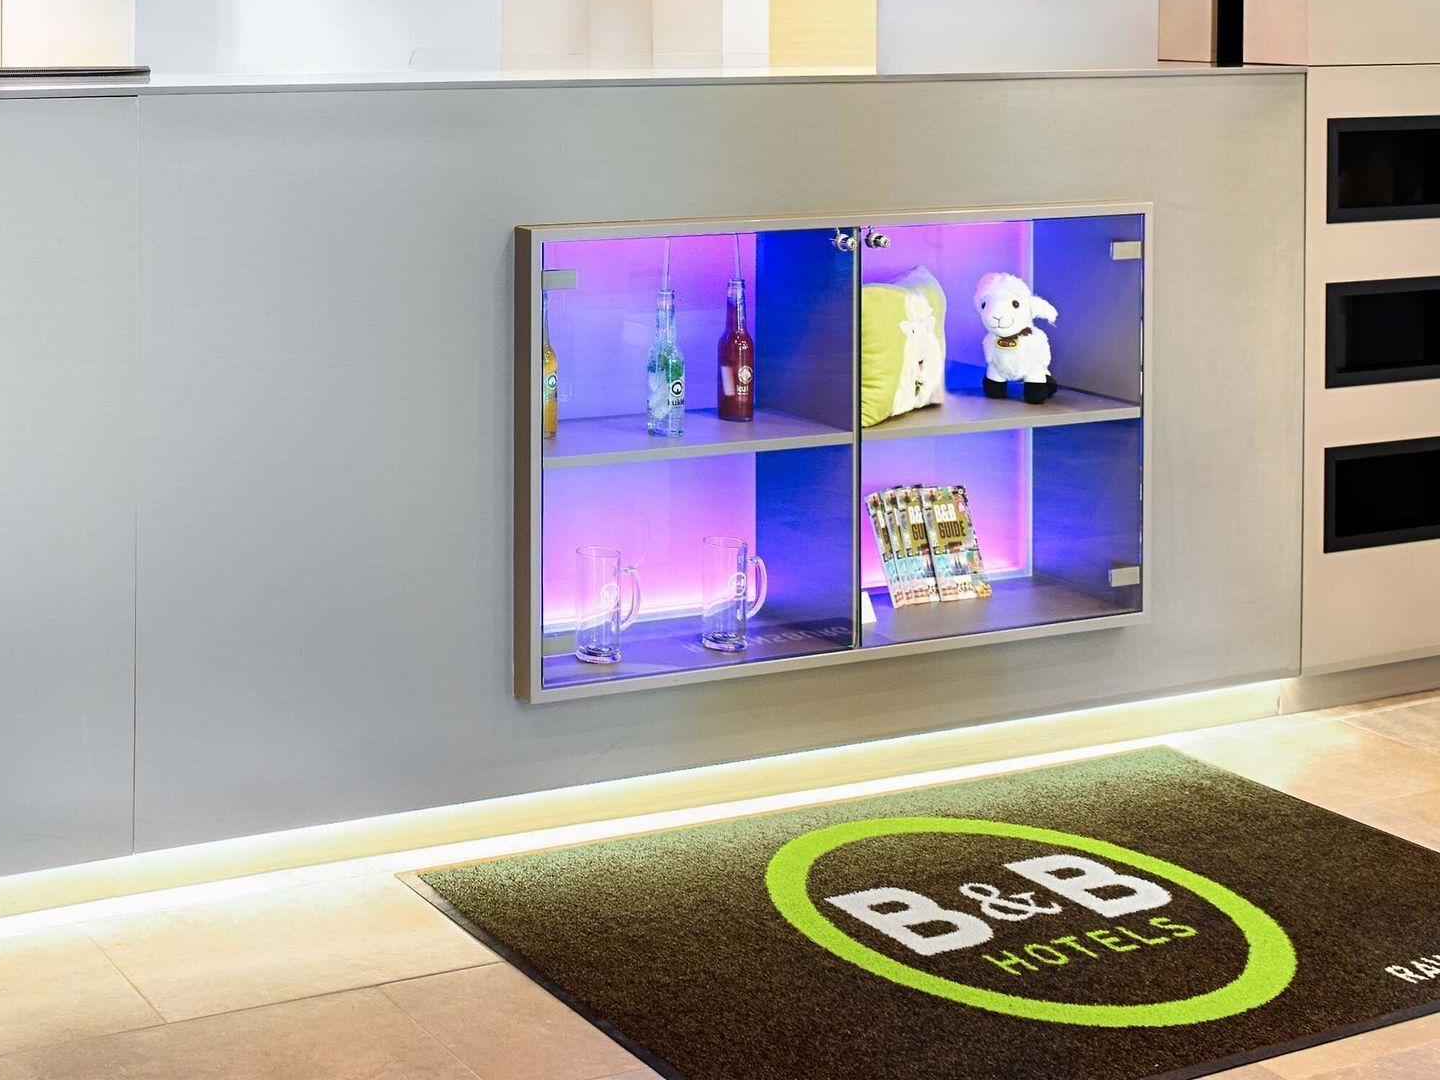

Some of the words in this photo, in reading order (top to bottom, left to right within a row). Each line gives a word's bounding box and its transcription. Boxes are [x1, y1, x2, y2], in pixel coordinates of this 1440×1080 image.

[938, 520, 967, 539] GUIDE
[824, 853, 1173, 957] B&B
[981, 916, 1198, 976] HOTELS
